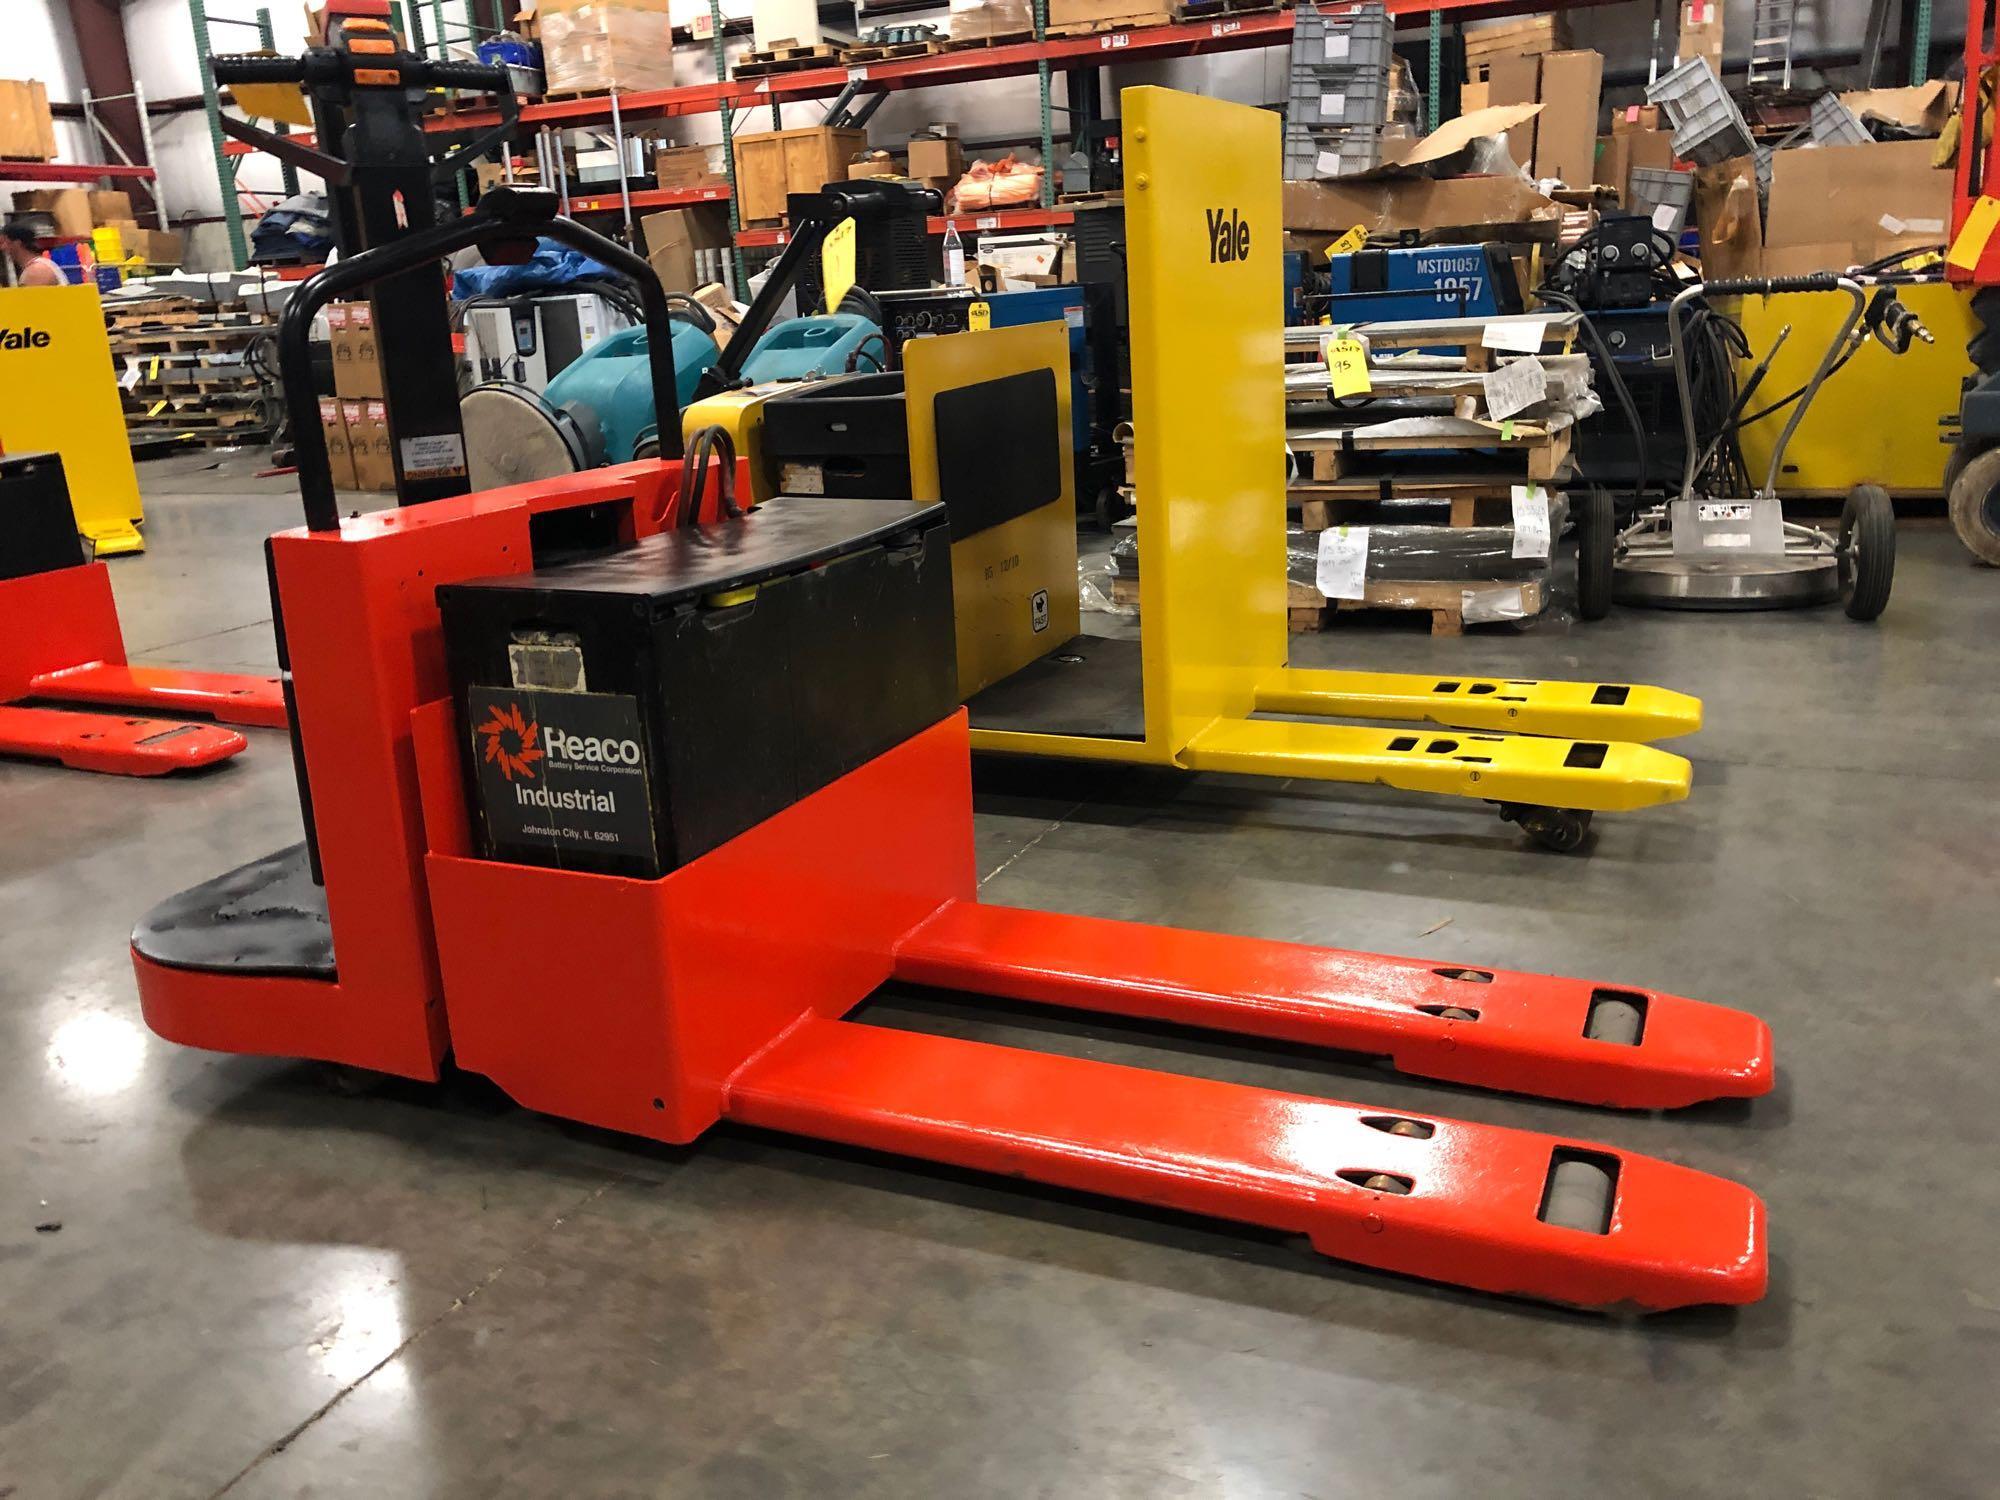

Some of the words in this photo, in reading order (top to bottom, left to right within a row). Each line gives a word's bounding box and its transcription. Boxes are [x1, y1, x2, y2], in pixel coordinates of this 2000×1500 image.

[1206, 208, 1249, 263] Yale
[1417, 257, 1480, 274] MSTD1057
[1434, 276, 1482, 303] 1057
[543, 726, 640, 765] Reaco
[549, 760, 572, 771] Battery
[574, 762, 600, 773] Service
[600, 765, 642, 775] Corporation
[515, 783, 615, 813] Industrial
[522, 824, 561, 837] Johnston
[594, 831, 619, 843] 62951
